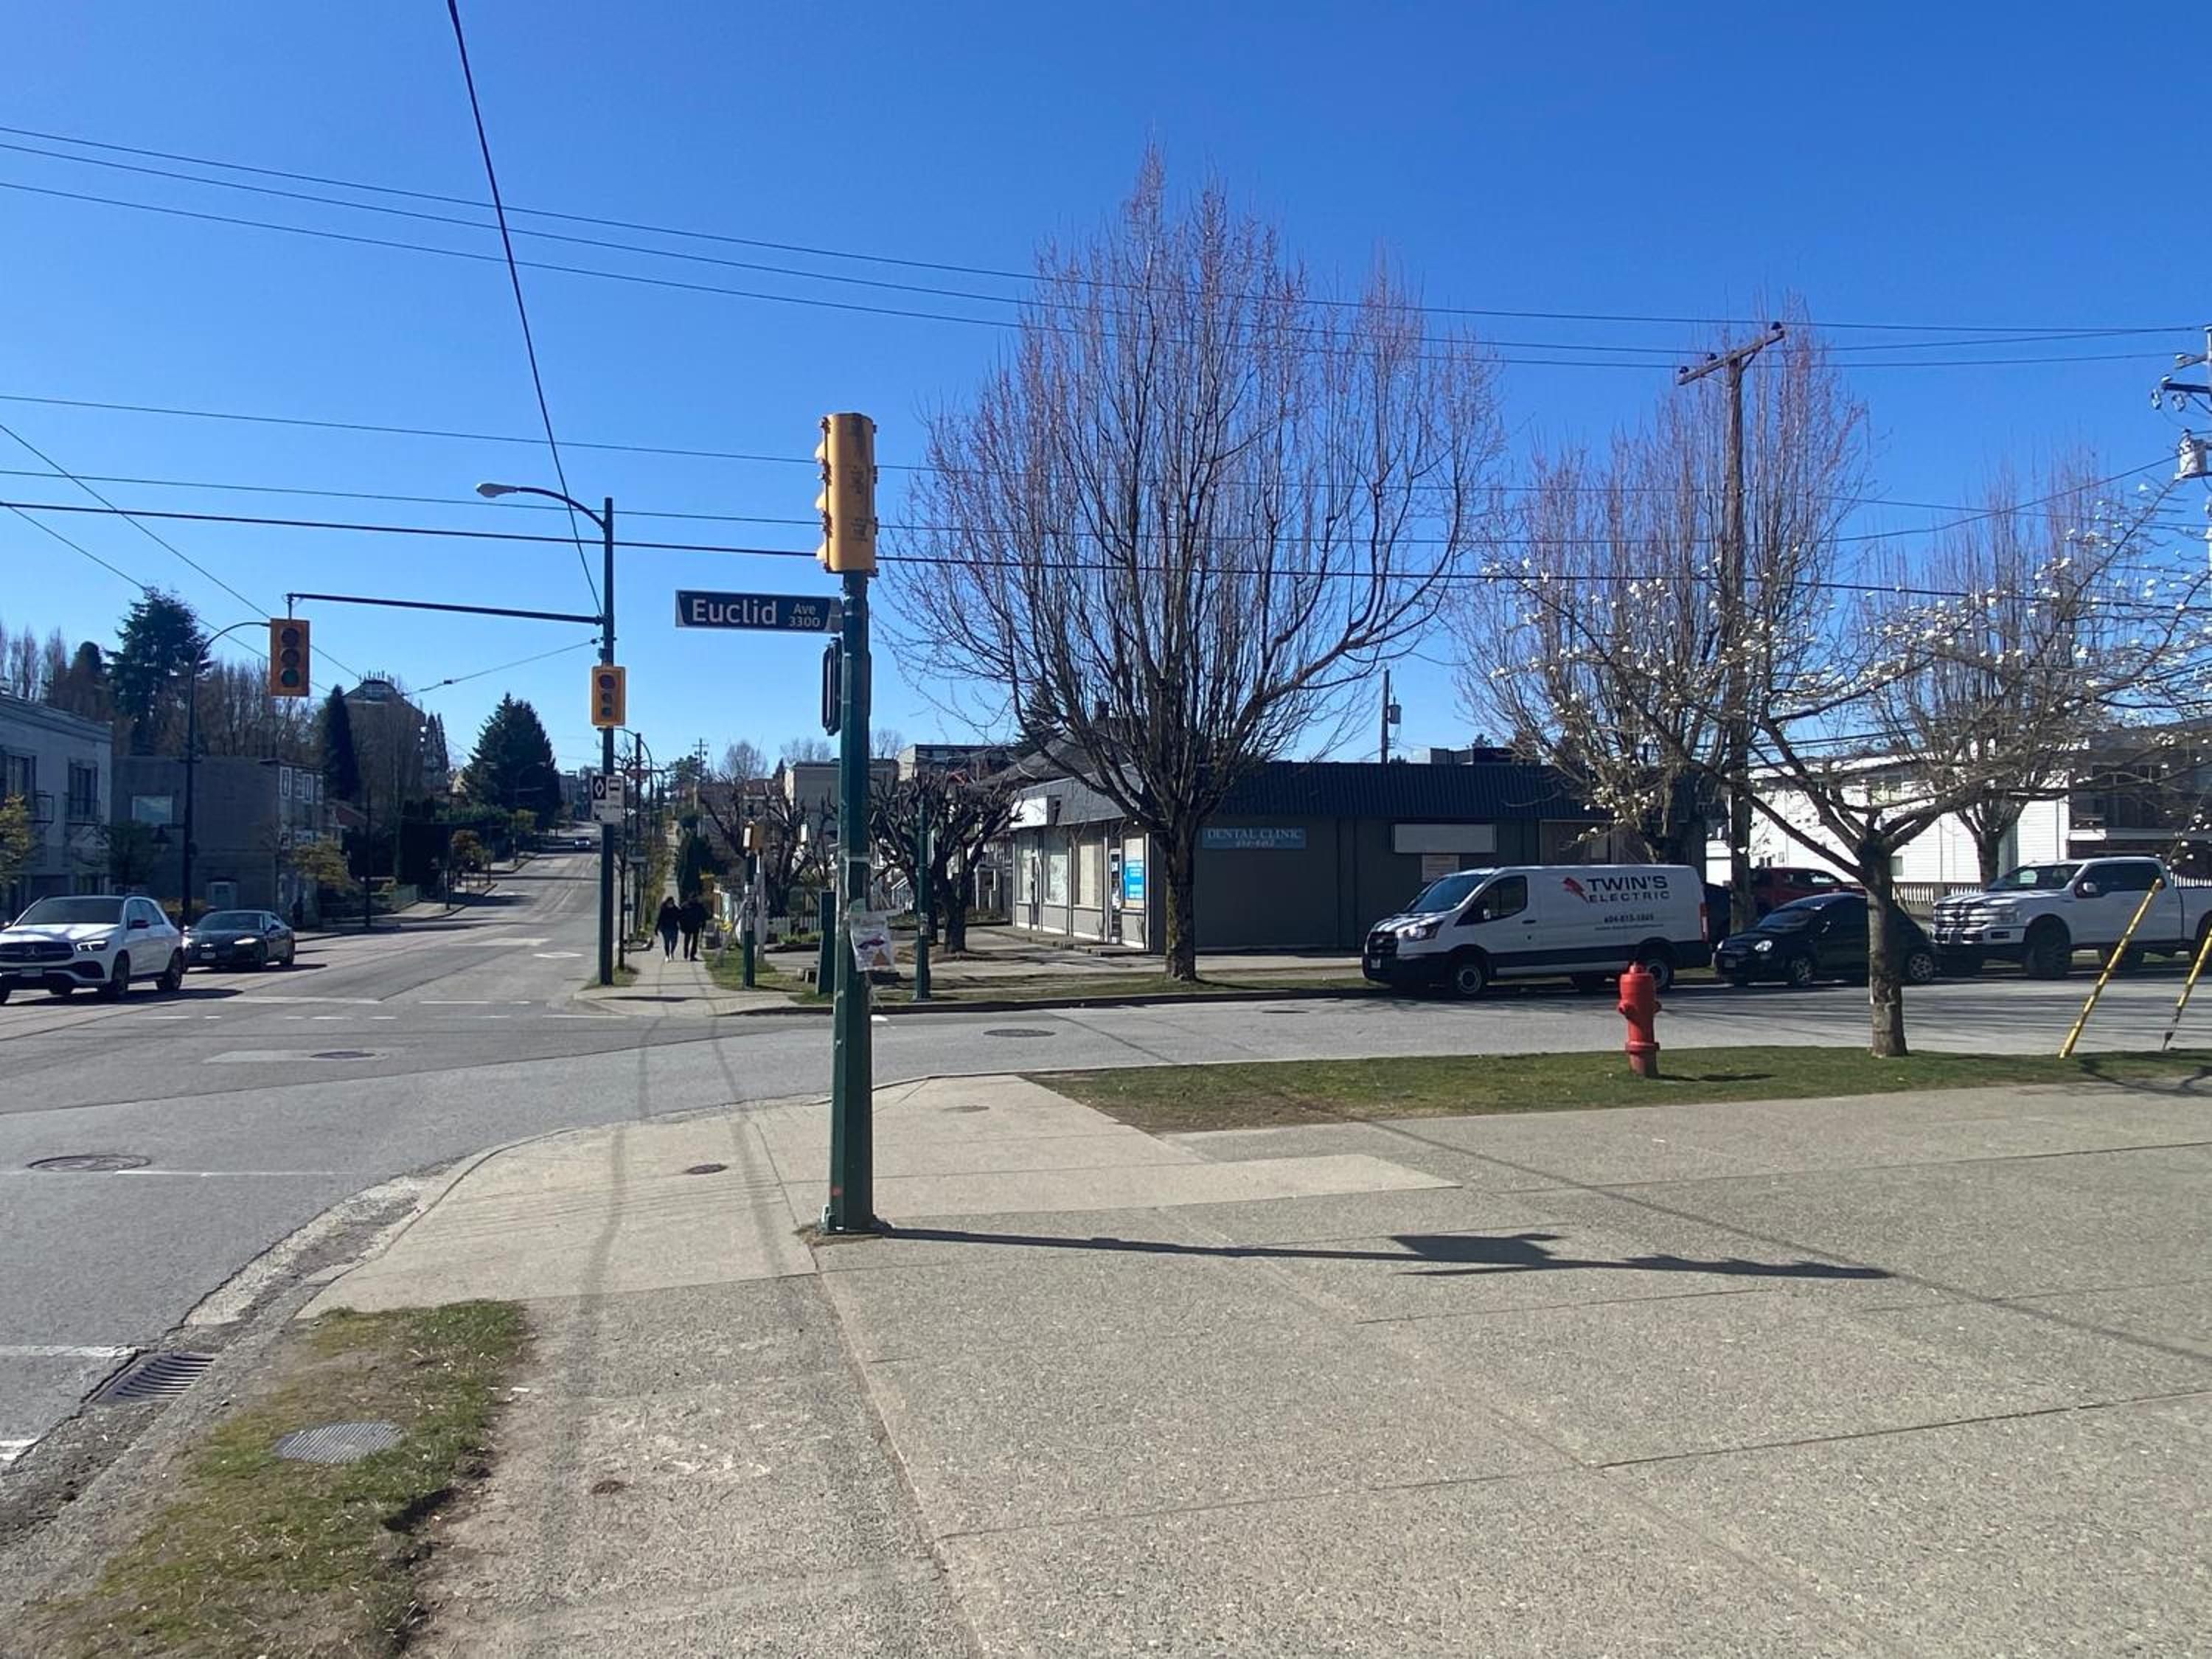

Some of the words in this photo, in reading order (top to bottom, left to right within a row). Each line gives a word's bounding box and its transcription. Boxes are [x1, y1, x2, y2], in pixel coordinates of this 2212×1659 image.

[692, 598, 776, 625] Euclid
[793, 602, 816, 616] Ave
[788, 616, 821, 628] 3300
[1207, 827, 1256, 839] DENTAL
[1259, 827, 1303, 839] CLINIC
[1586, 875, 1669, 892] TWIN'S
[1588, 890, 1670, 904] ELECTRIC
